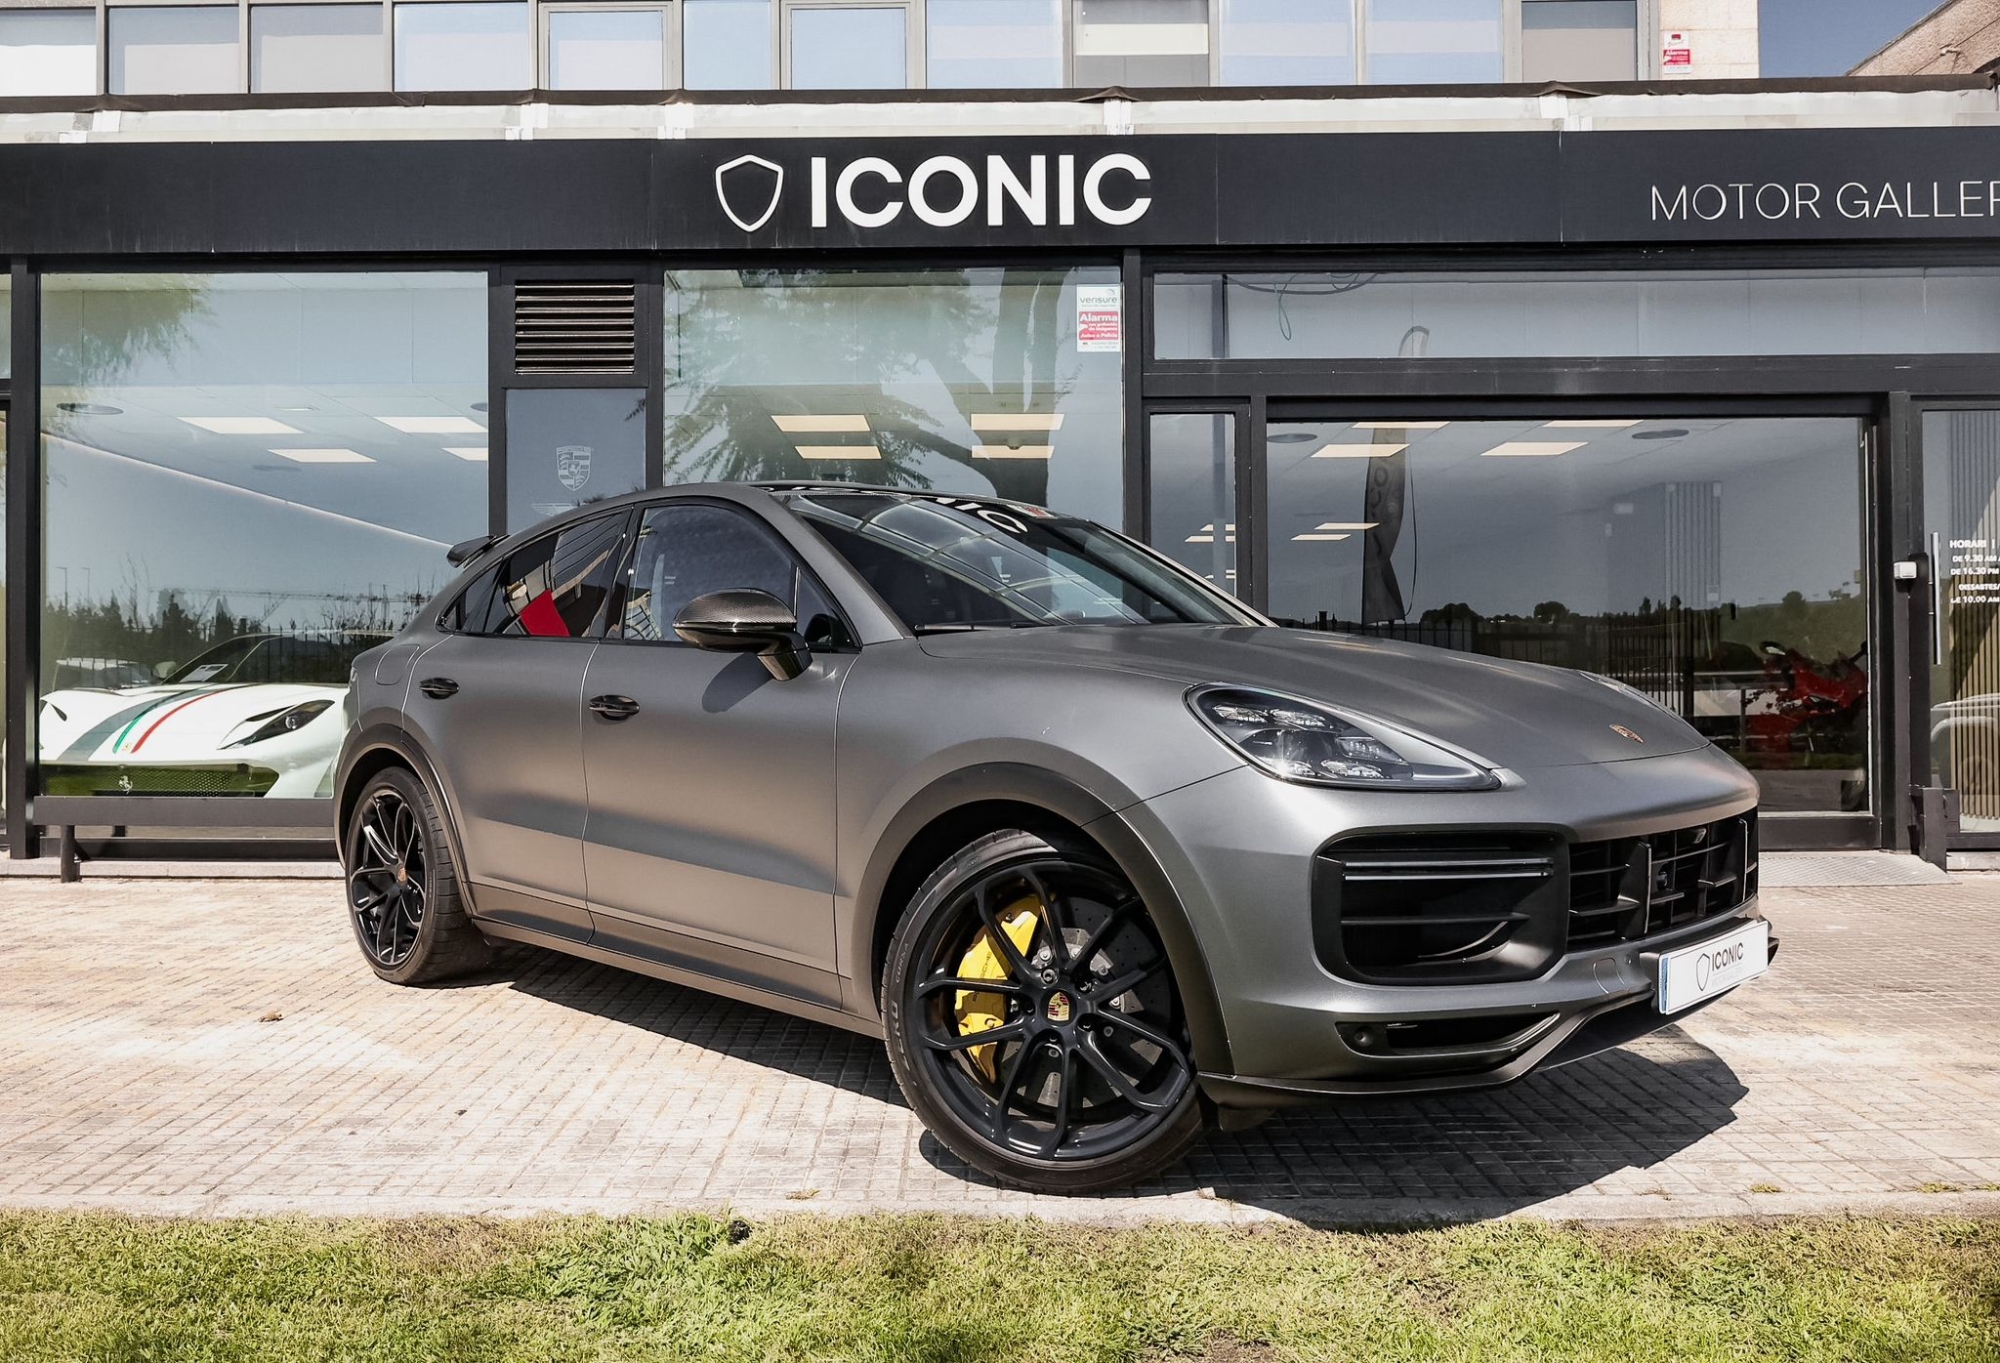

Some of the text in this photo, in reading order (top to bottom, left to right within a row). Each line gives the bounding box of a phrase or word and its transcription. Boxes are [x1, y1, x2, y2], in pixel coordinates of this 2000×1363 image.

[811, 153, 1152, 228] ICONIC
[1651, 182, 1821, 221] MOTOR
[1080, 296, 1118, 304] verisure
[1080, 313, 1118, 321] Alarma
[1949, 540, 1987, 548] HORARI
[1964, 554, 1984, 562] 9.30
[1962, 567, 1986, 575] 16.30
[1962, 595, 1986, 603] 10.00
[1711, 942, 1744, 971] ICONIC
